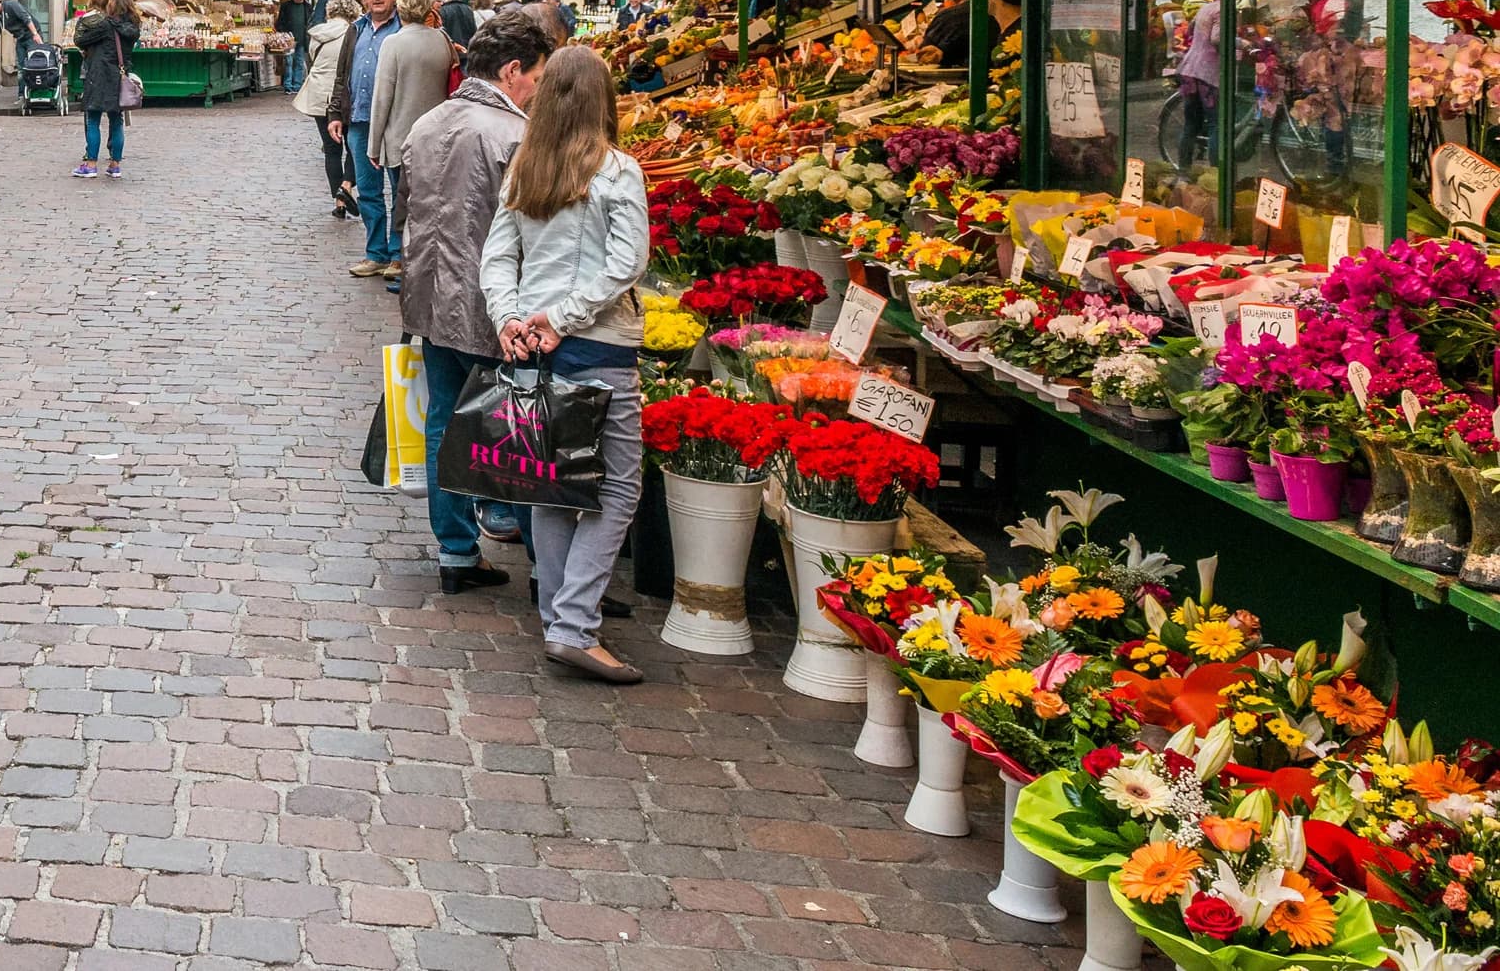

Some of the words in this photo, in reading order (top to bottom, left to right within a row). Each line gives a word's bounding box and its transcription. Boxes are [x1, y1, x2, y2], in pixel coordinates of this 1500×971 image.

[1047, 63, 1055, 86] 7
[1061, 63, 1095, 95] ROSE
[861, 379, 930, 419] GAROFANI
[470, 441, 558, 484] RUTH
